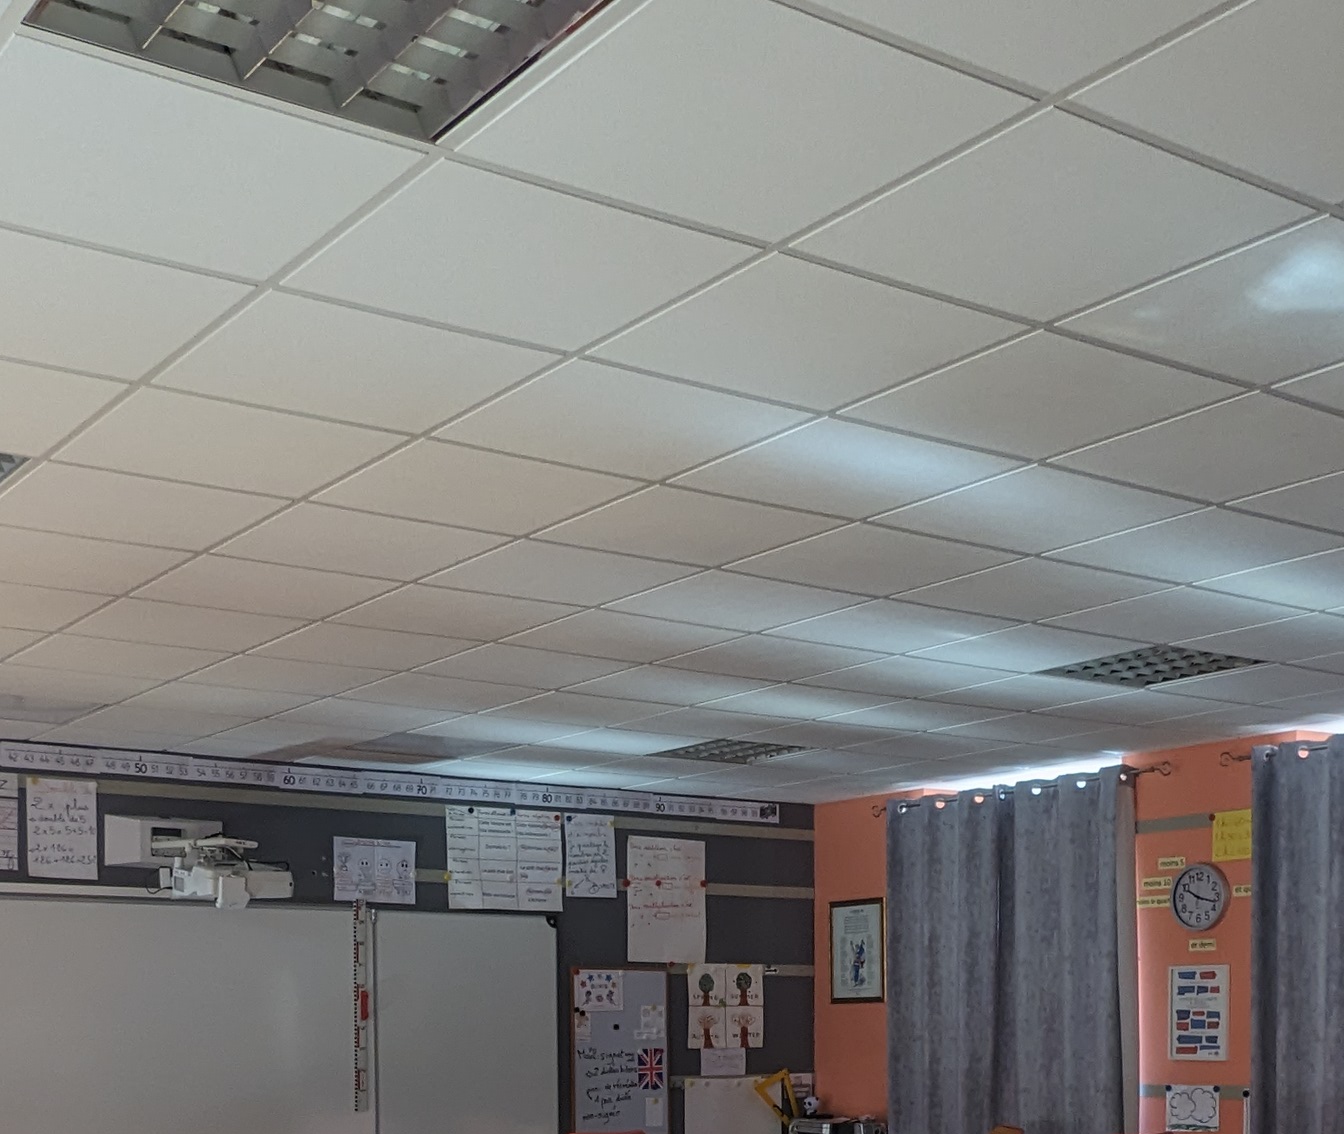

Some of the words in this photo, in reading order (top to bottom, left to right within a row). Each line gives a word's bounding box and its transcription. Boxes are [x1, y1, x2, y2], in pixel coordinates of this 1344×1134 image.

[135, 763, 148, 774] 50
[283, 775, 296, 785] 60
[417, 785, 427, 795] 70
[542, 793, 552, 803] 80
[655, 803, 665, 812] 90
[1189, 875, 1195, 884] 11
[1196, 872, 1204, 881] 12
[1206, 875, 1210, 884] 1
[1211, 881, 1217, 891] 2
[1179, 893, 1184, 903] 9
[1215, 892, 1220, 902] 3
[1181, 904, 1187, 913] 8
[1211, 904, 1216, 912] 4
[1188, 911, 1193, 920] 7
[1196, 914, 1201, 923] 6
[1204, 911, 1210, 920] 5
